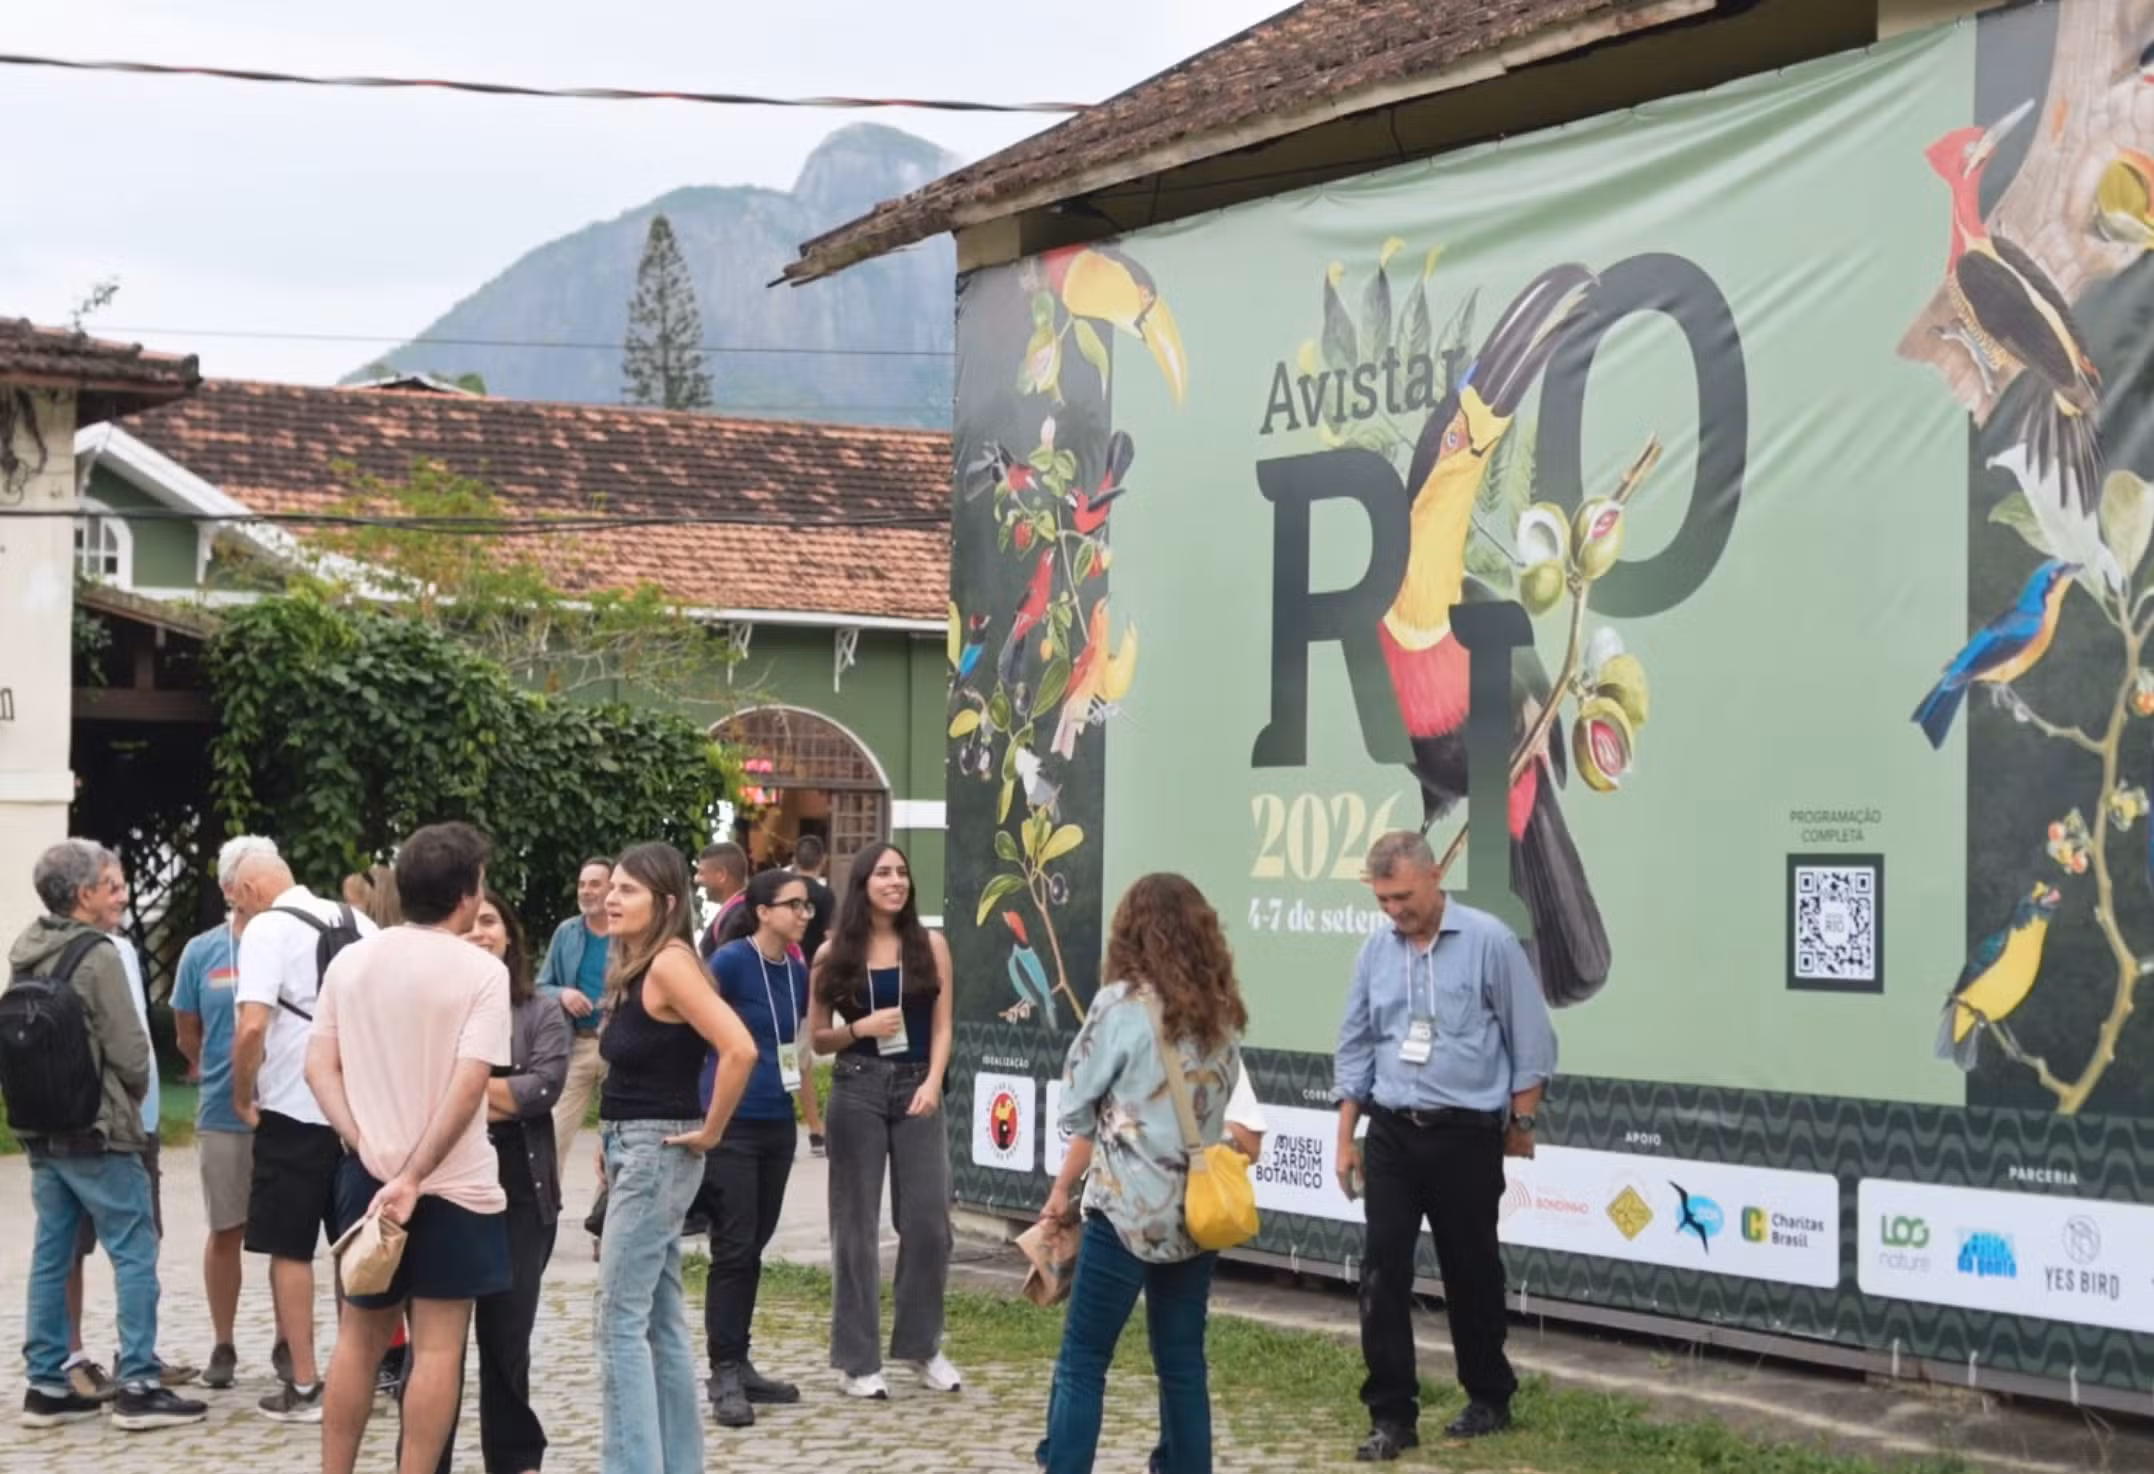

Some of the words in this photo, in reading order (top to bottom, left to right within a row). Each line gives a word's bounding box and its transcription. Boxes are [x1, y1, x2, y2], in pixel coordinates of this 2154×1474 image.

[1260, 345, 1466, 435] Avistar
[1790, 808, 1882, 824] PROGRAMAÇÃO
[1801, 829, 1865, 843] COMPLETA
[1248, 897, 1283, 931] 4-7
[1287, 897, 1315, 933] de
[1320, 901, 1392, 935] sete
[1273, 1134, 1323, 1155] MUSEU
[1625, 1131, 1662, 1146] APOIO
[1272, 1151, 1323, 1171] JARDIM
[2008, 1165, 2078, 1185] PARCERIA
[1771, 1213, 1825, 1232] Charitas
[1771, 1231, 1808, 1248] Brasil
[1879, 1252, 1931, 1274] nature
[2045, 1266, 2075, 1291] YES
[2080, 1270, 2120, 1302] BIRD
